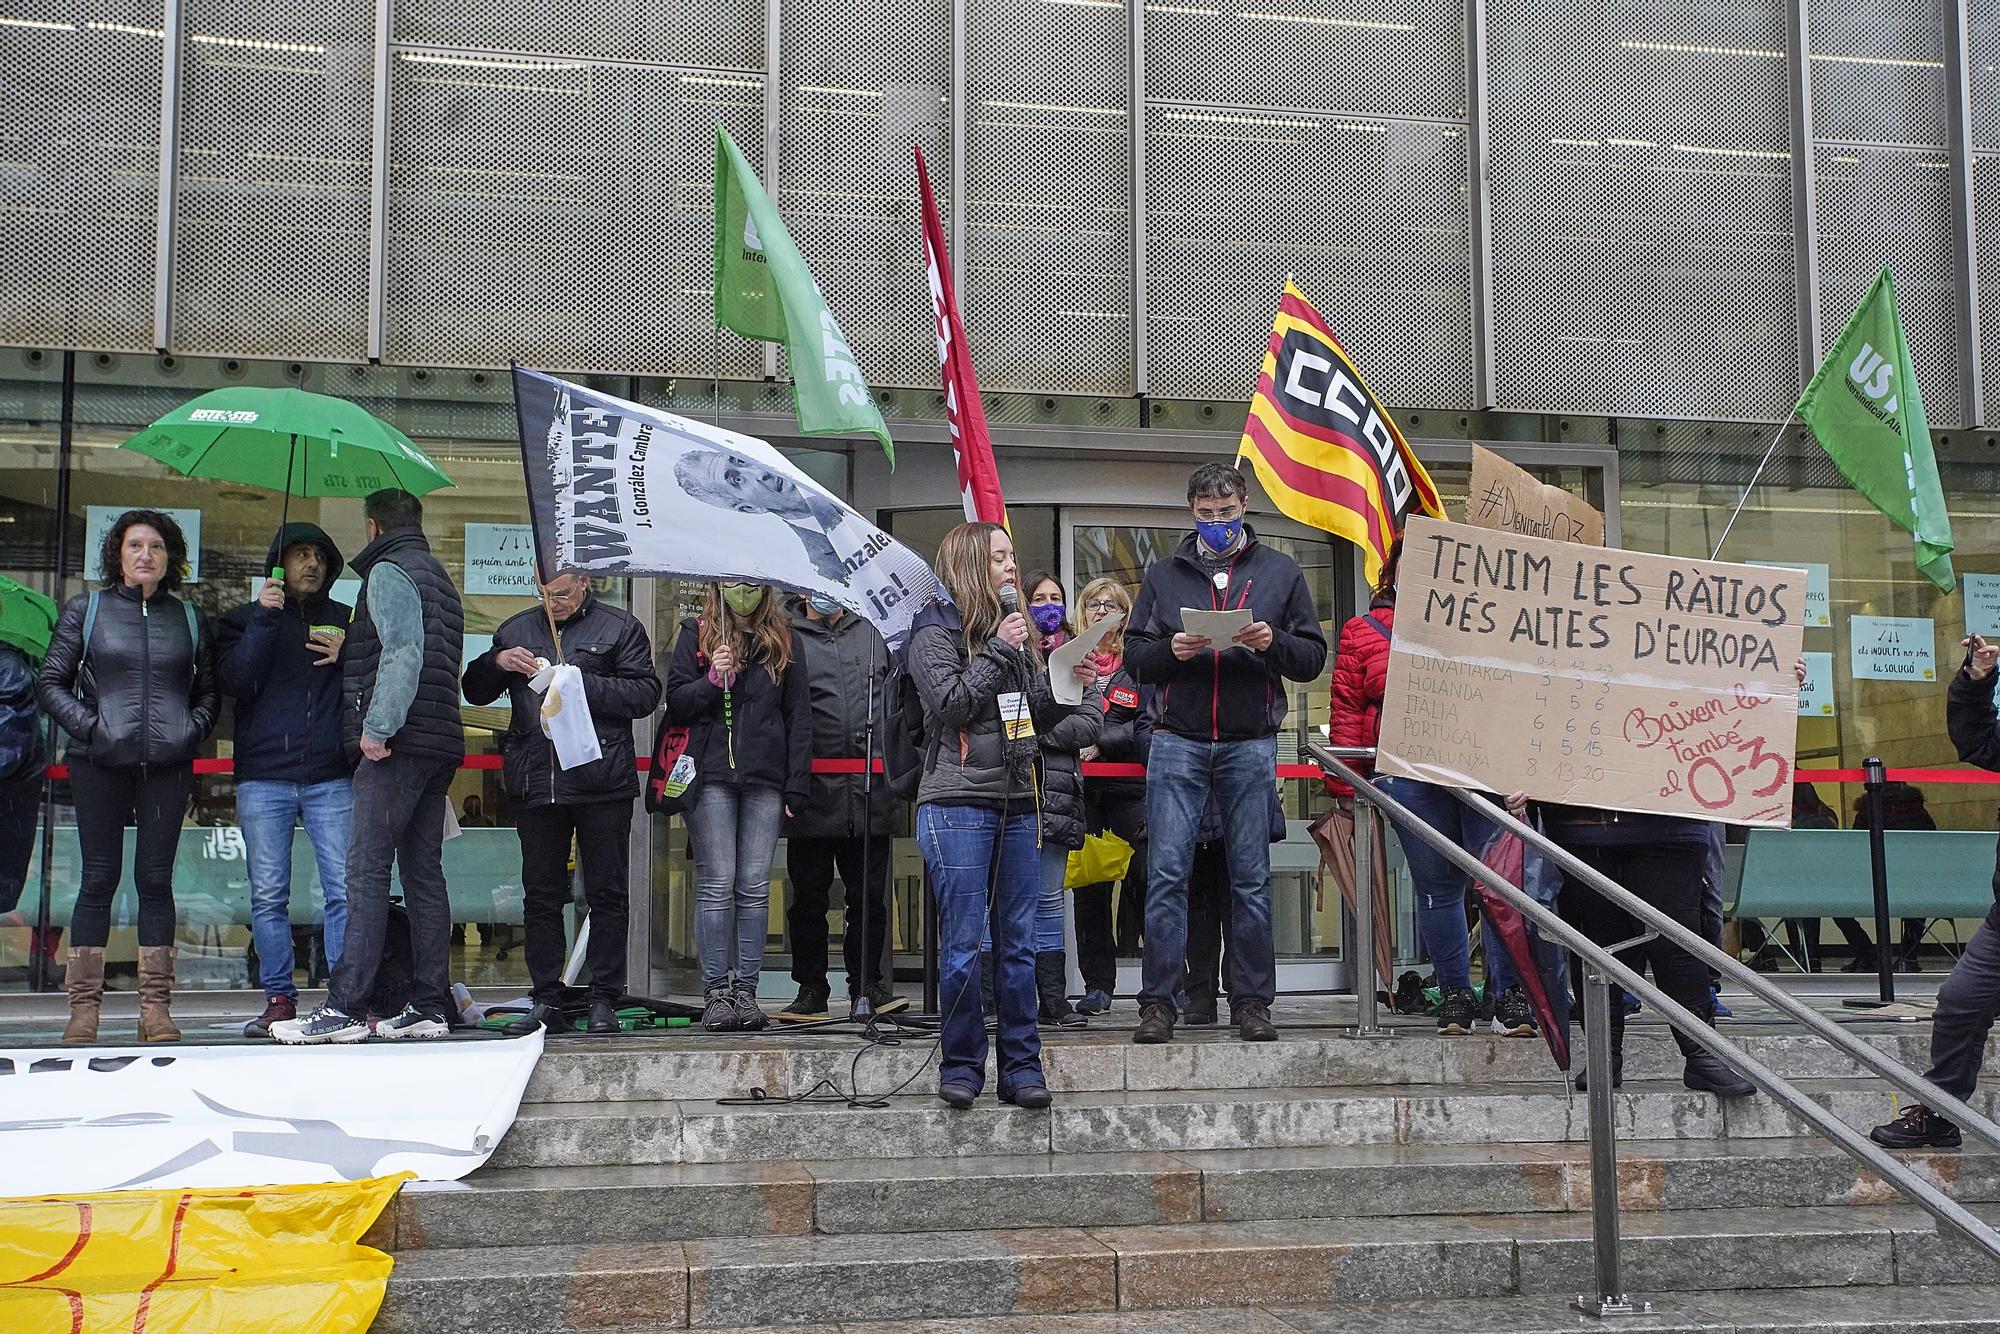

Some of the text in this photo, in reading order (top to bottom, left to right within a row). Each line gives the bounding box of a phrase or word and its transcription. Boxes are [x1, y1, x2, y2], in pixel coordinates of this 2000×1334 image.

[1284, 349, 1412, 516] CCOO
[627, 423, 653, 528] J. González Cambra
[866, 572, 909, 621] ja!
[1427, 534, 1789, 628] TENIM LES RÀTIOS
[1424, 591, 1780, 672] MÉS ALTES D'EUROPA
[1407, 672, 1605, 711] HOLANDA 4 5 6
[1540, 671, 1551, 687] 3
[1600, 676, 1611, 694] 3
[1402, 717, 1604, 757] PORTUGAL 4 5 15
[1403, 694, 1601, 736] ITÀLIA 6 6 6
[1623, 682, 1773, 749] Baixem-la
[1395, 742, 1605, 783] CATALUNYA 8 13 20
[1665, 719, 1743, 764] també
[1659, 735, 1789, 810] al 0-3
